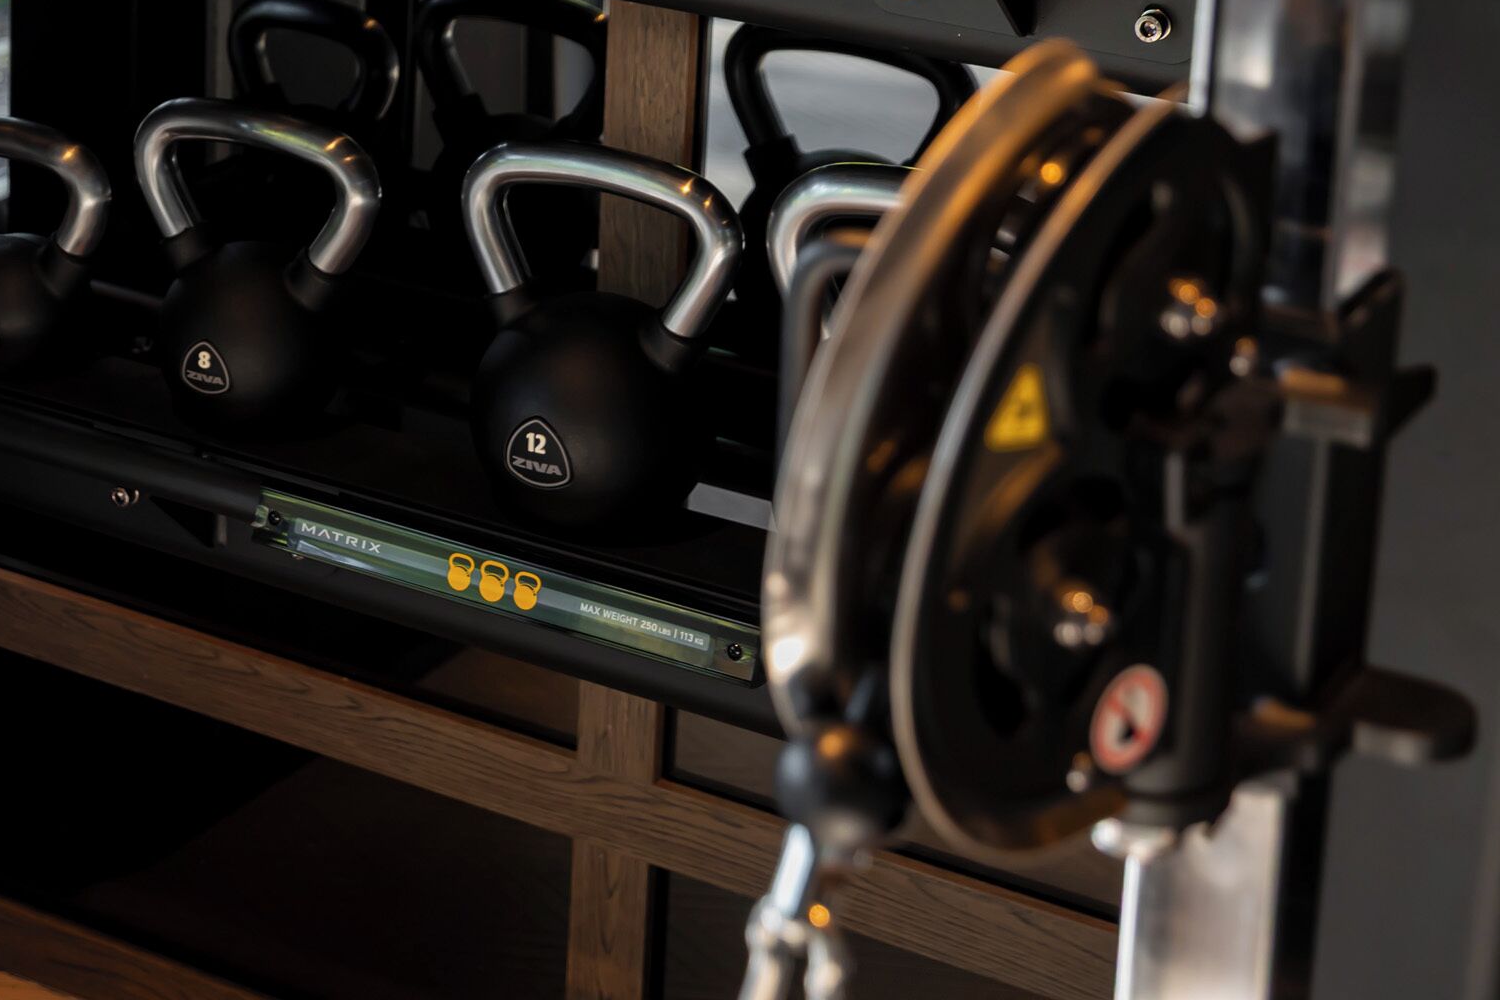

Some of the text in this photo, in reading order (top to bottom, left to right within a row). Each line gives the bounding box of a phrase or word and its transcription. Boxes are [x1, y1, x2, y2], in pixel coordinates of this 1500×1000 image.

[197, 350, 211, 369] 8
[186, 368, 225, 386] ZIVA
[525, 431, 547, 455] 12
[511, 455, 563, 476] ZIVA
[301, 522, 381, 554] MATRIX
[579, 602, 601, 616] MAX
[603, 608, 638, 626] WEIGHT
[640, 619, 657, 632] 250
[657, 626, 672, 637] LBS
[680, 631, 694, 643] 113
